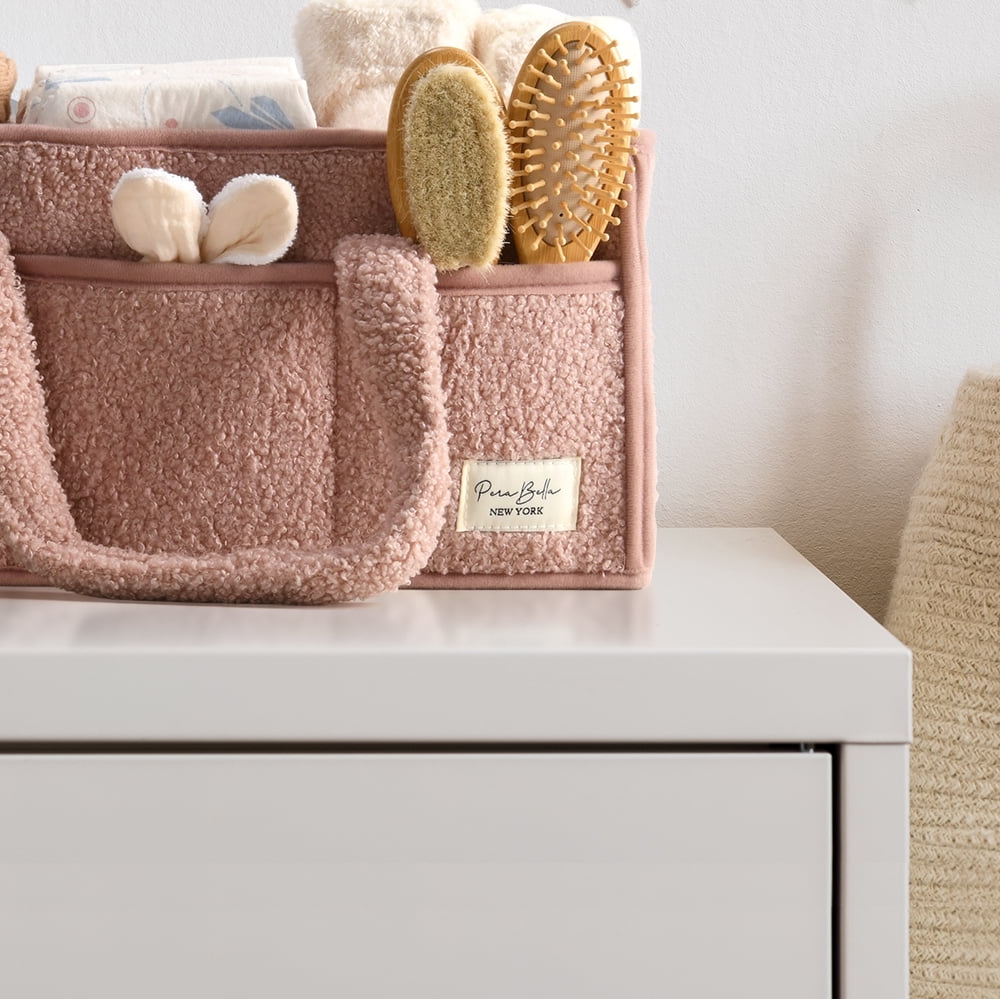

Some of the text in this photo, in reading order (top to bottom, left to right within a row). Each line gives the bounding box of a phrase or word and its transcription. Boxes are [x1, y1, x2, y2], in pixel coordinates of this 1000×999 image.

[515, 478, 561, 505] Bella
[489, 506, 544, 516] NEW YORK
